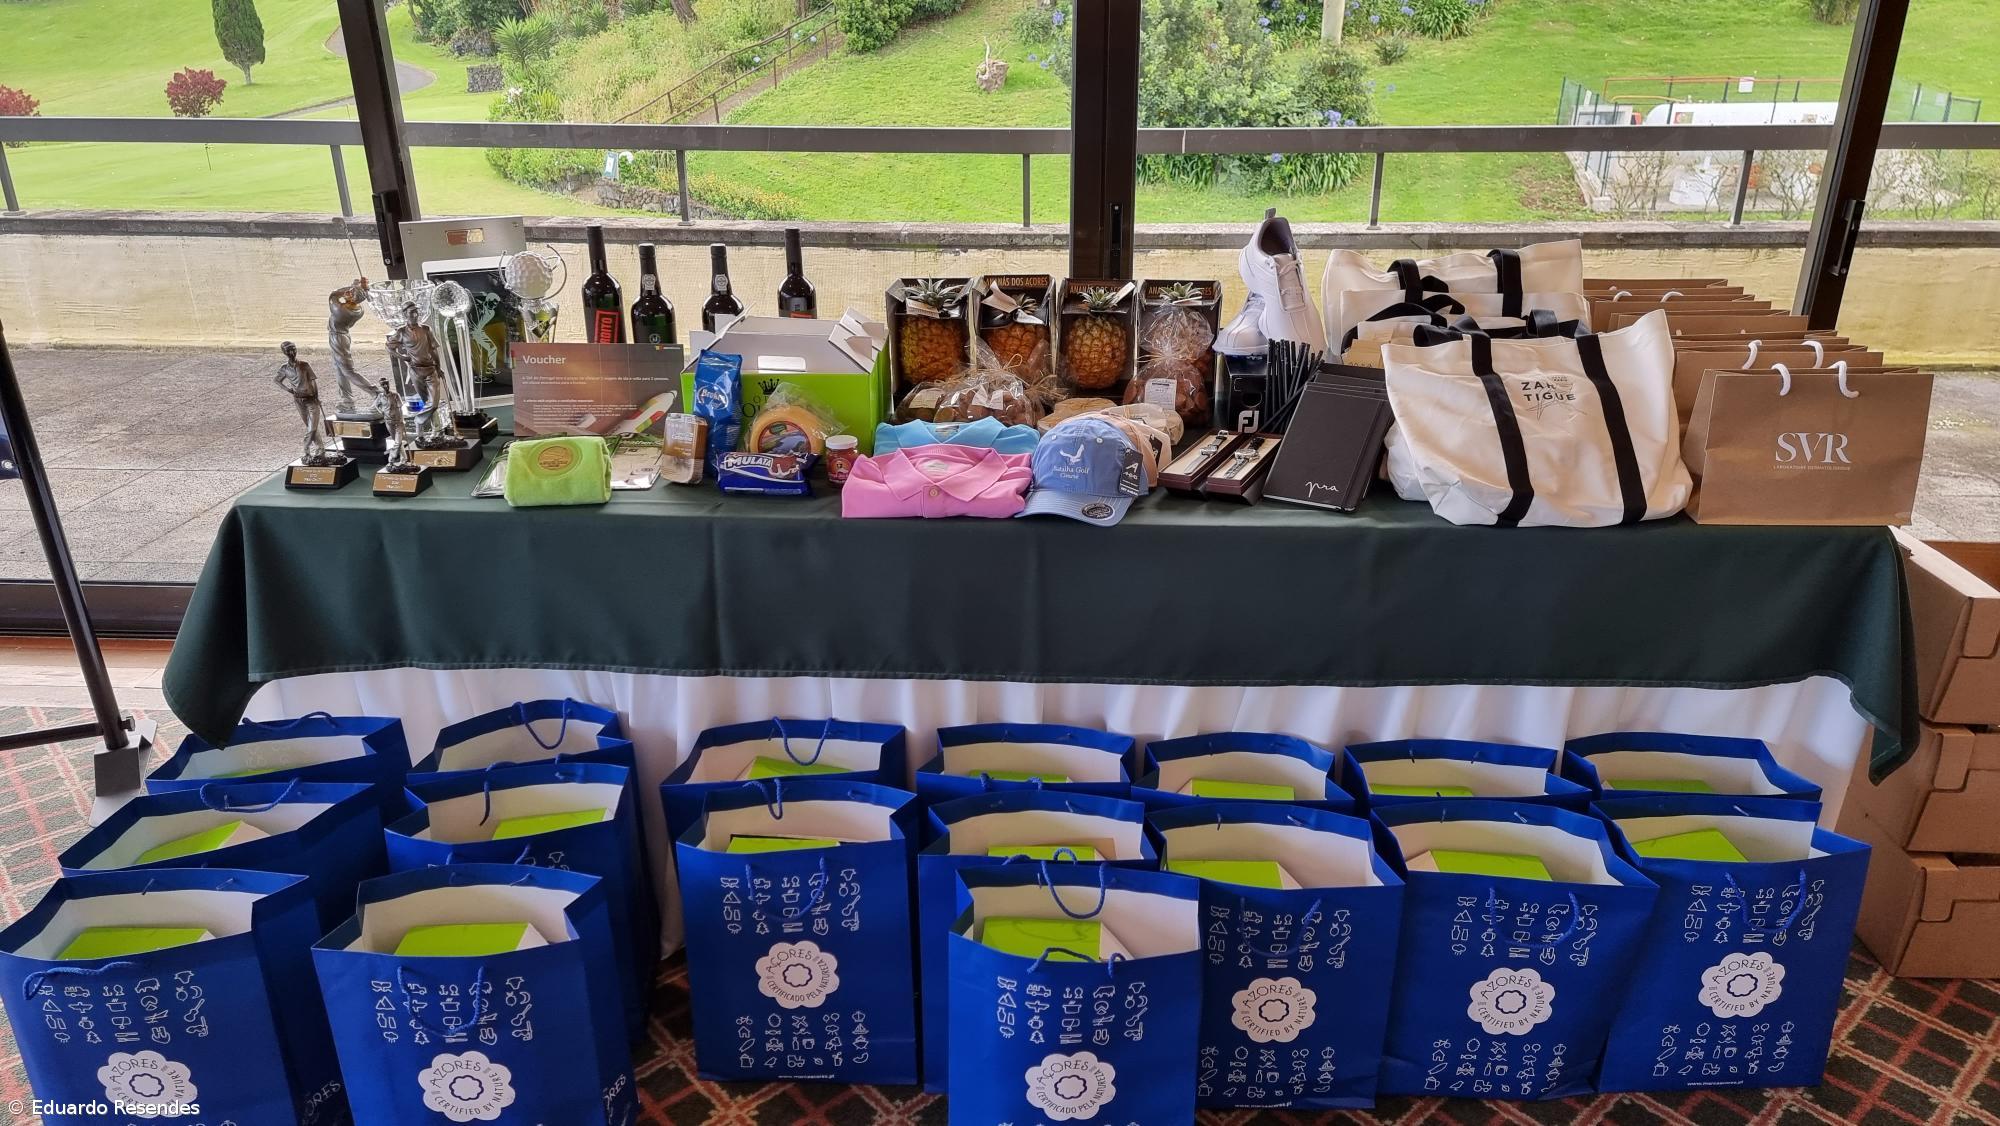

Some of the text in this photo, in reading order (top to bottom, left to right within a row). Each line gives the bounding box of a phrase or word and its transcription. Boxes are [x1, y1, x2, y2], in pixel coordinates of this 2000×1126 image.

[1012, 277, 1024, 286] DOS
[1025, 277, 1048, 287] AÇORES
[522, 355, 567, 364] Voucher
[1524, 392, 1576, 401] TIGUE
[1237, 410, 1260, 433] FJ
[727, 456, 771, 467] MULATA
[1775, 432, 1852, 464] SVR
[766, 949, 812, 975] AÇORES
[1712, 959, 1765, 984] AZORES
[767, 959, 830, 1002] CERTIFICADO PELA NATUREZA
[1480, 974, 1533, 1000] AZORES
[1709, 971, 1776, 1011] CERTIFIED BY NATURE
[1242, 984, 1293, 1009] AZORES
[1478, 990, 1545, 1028] CERTIFIED BY NATURE
[1241, 996, 1308, 1036] CERTIFIED BY NATURE
[109, 1058, 158, 1085] AZORES
[167, 1069, 185, 1098] NATURE
[430, 1060, 481, 1088] AZORES
[1036, 1060, 1089, 1087] AÇORES
[434, 1072, 504, 1115] CERTIFIED BY NATURE
[1036, 1069, 1107, 1114] CERTIFICADO PELA NATUREZA
